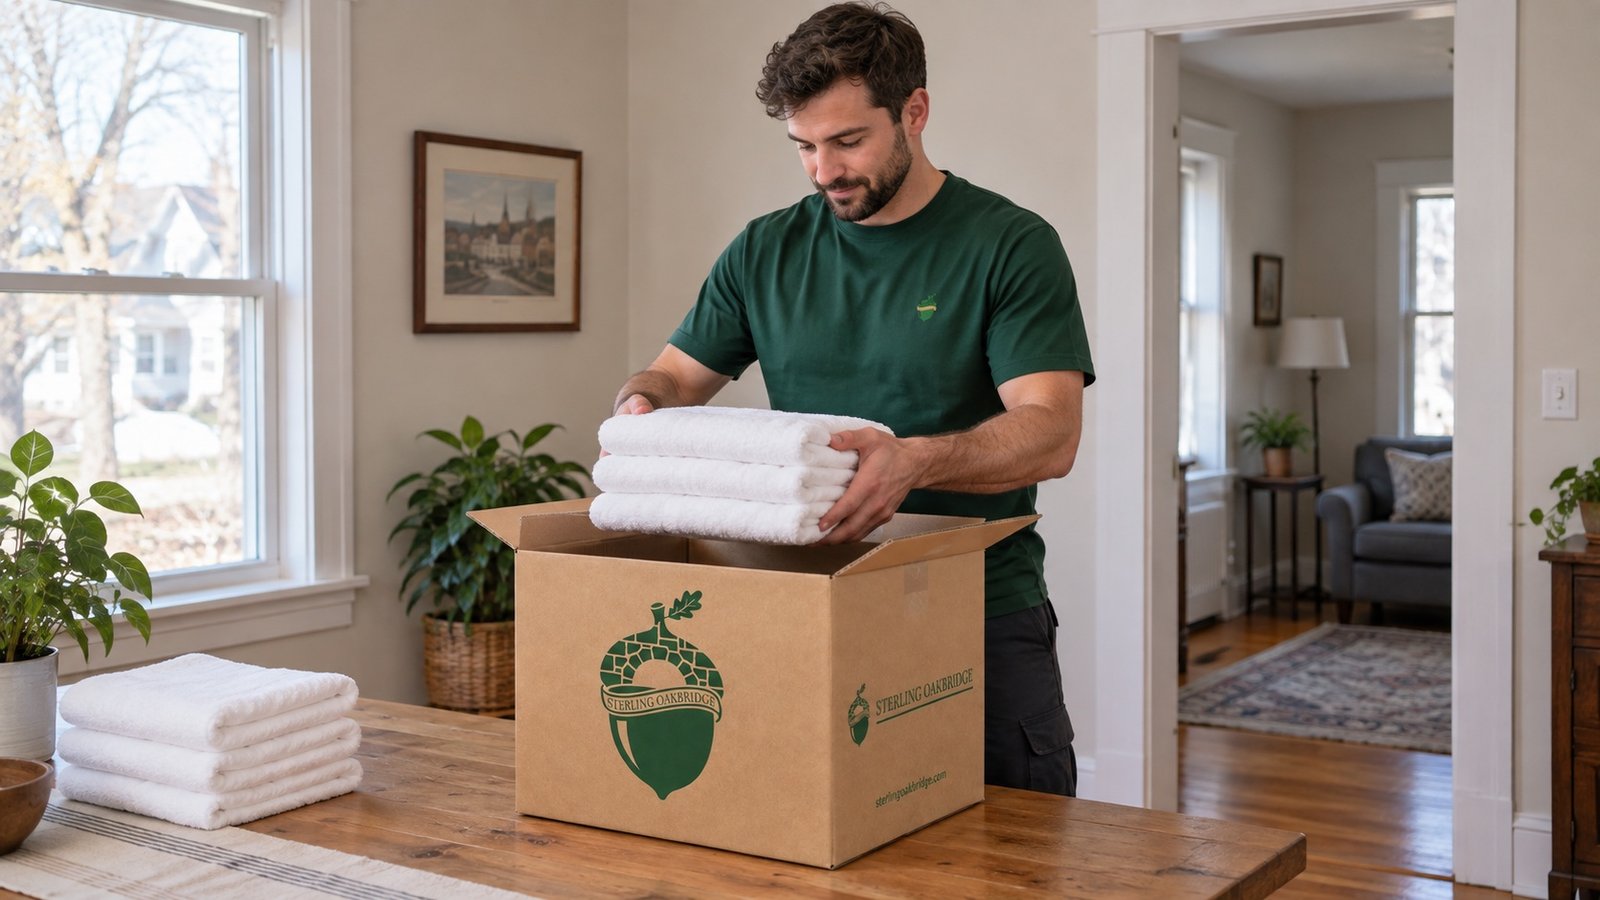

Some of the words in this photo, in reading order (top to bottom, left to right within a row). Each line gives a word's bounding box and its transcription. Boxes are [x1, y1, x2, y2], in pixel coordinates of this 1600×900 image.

[607, 697, 655, 711] STERLING
[656, 691, 716, 707] OAKBRIDGE
[876, 686, 922, 716] STERLING
[923, 668, 973, 698] OAKBRIDGE
[875, 770, 947, 808] sterlingoakbridge.com
